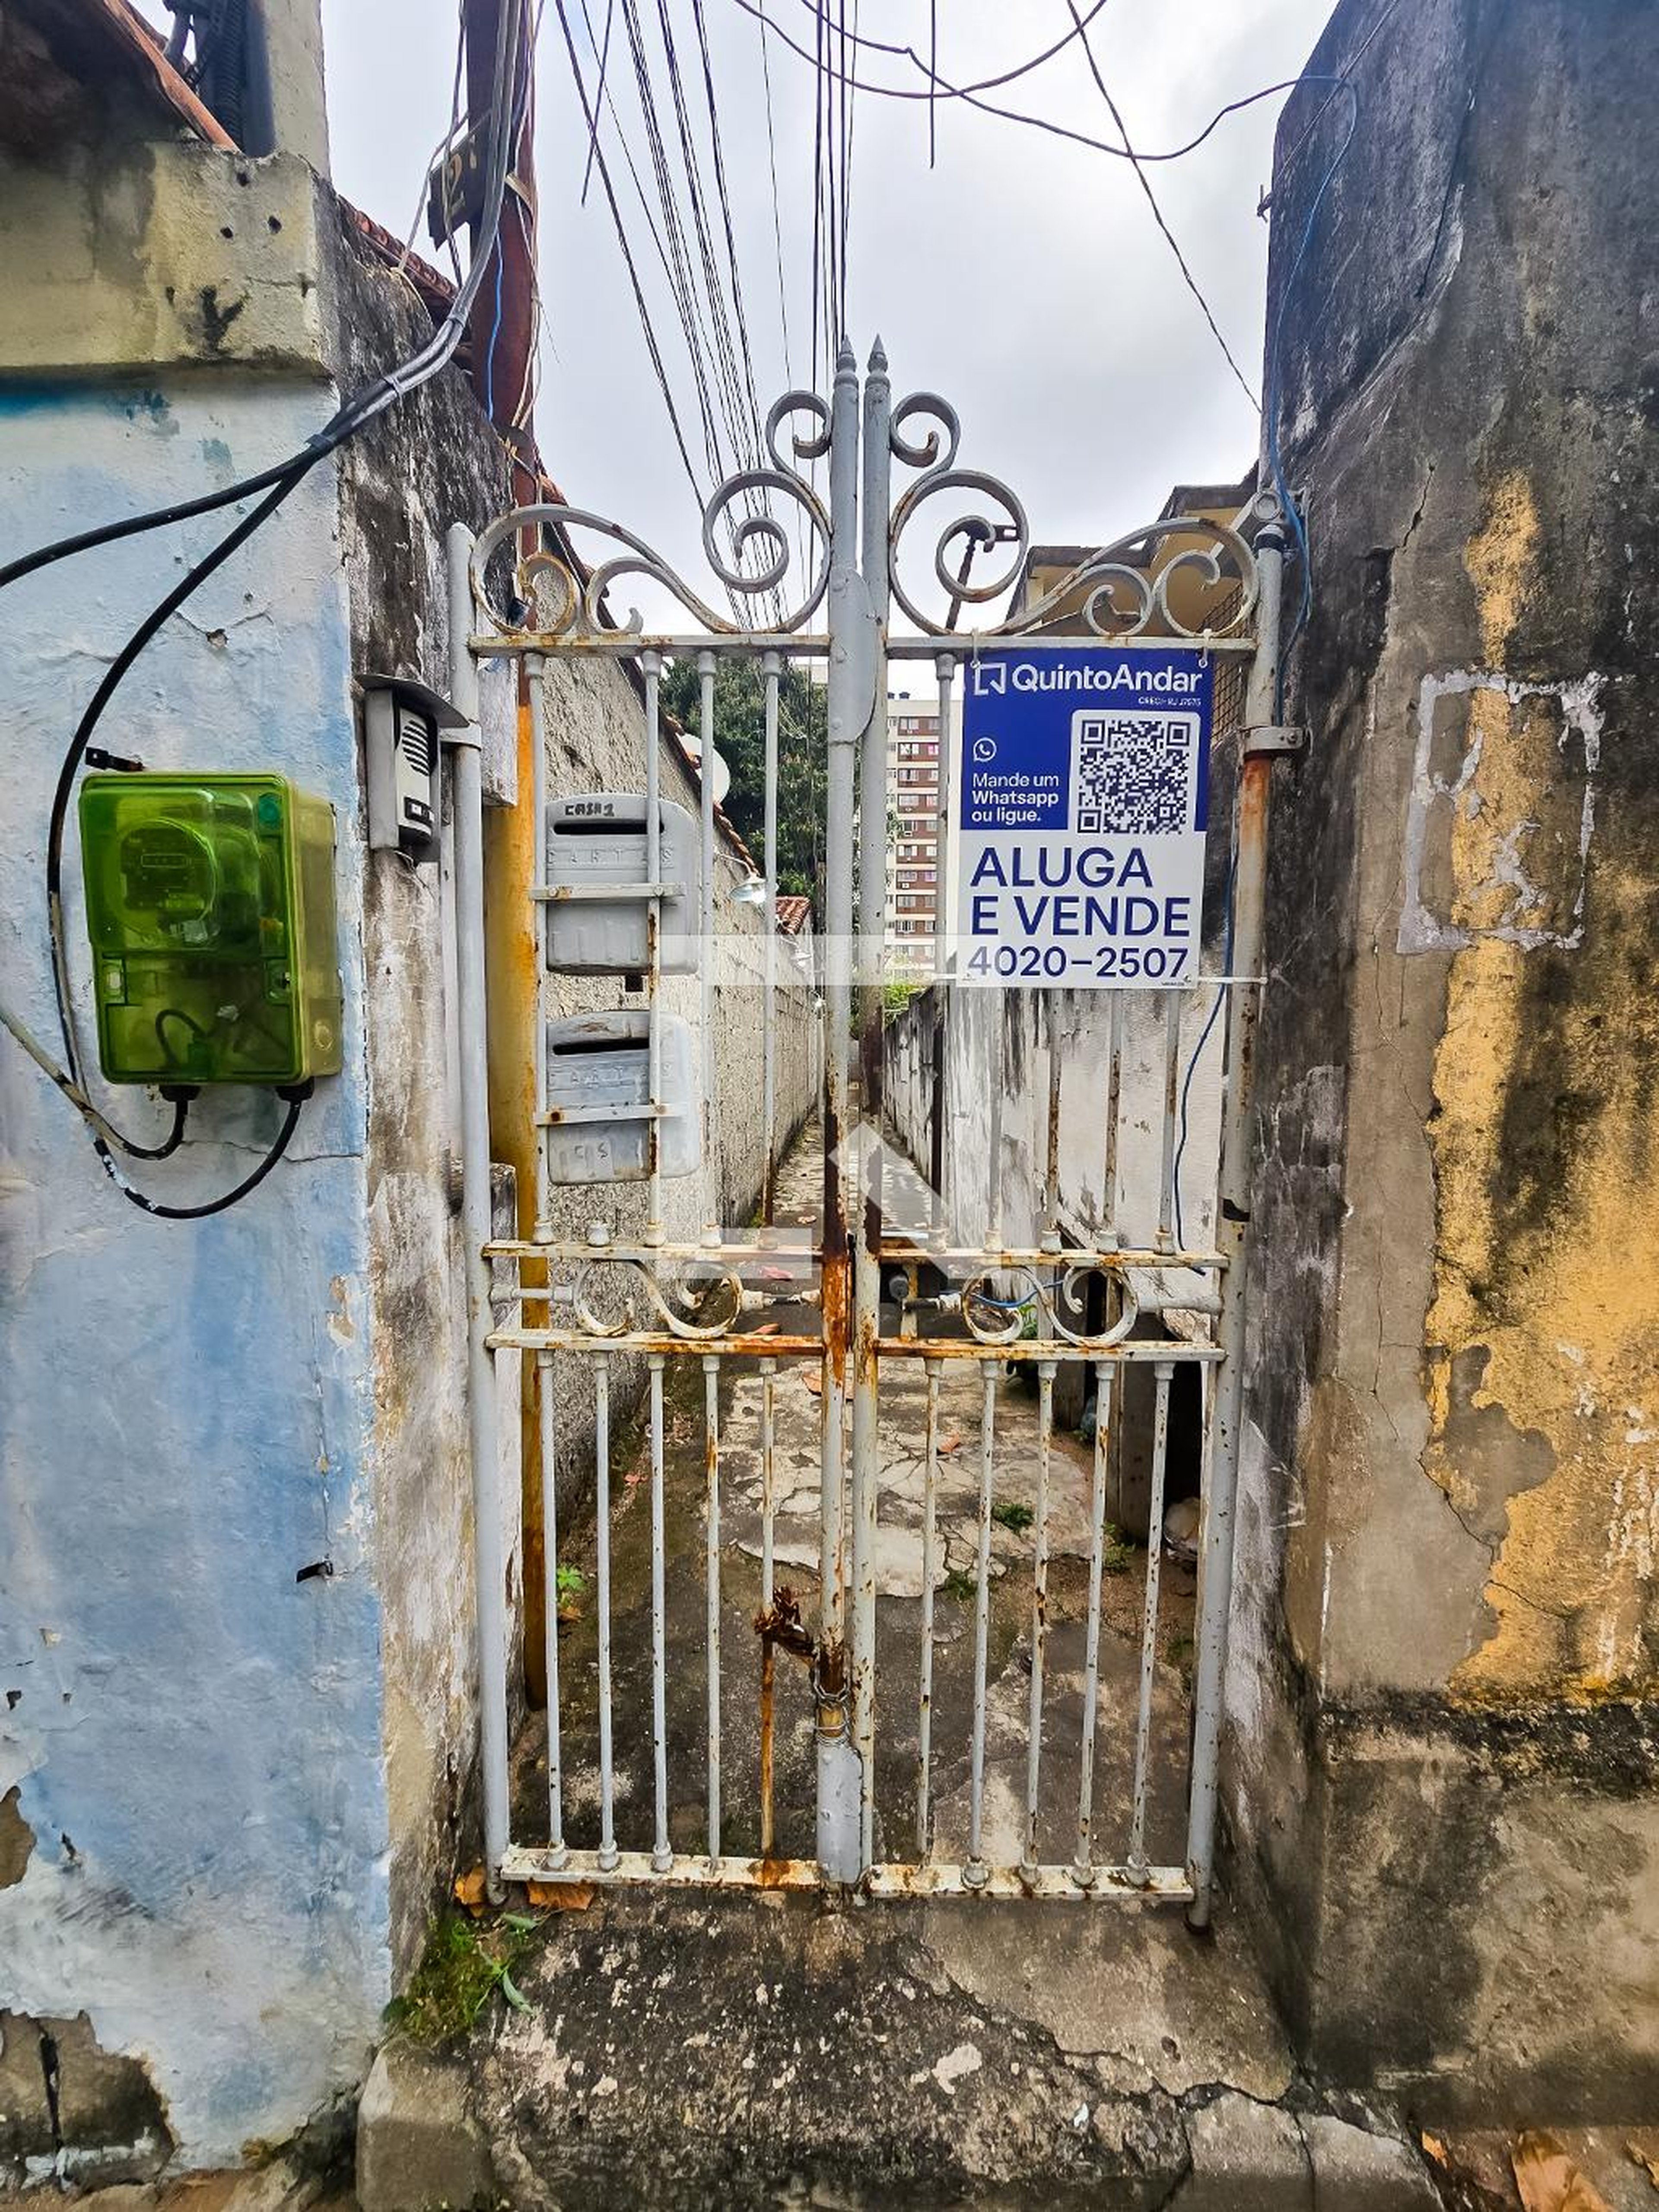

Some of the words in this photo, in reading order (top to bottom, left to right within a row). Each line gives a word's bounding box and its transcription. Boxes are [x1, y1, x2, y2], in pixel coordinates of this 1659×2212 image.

[1012, 663, 1203, 692] QuintoAndar
[973, 772, 1029, 787] Mande
[1033, 777, 1059, 788] um
[972, 790, 1059, 807] Whatsapp
[972, 812, 993, 822] ou
[996, 807, 1042, 826] ligue.
[969, 847, 1154, 888] ALUGA
[971, 896, 999, 936] E
[1014, 896, 1191, 937] VENDE
[968, 945, 1188, 978] 4020-2507
